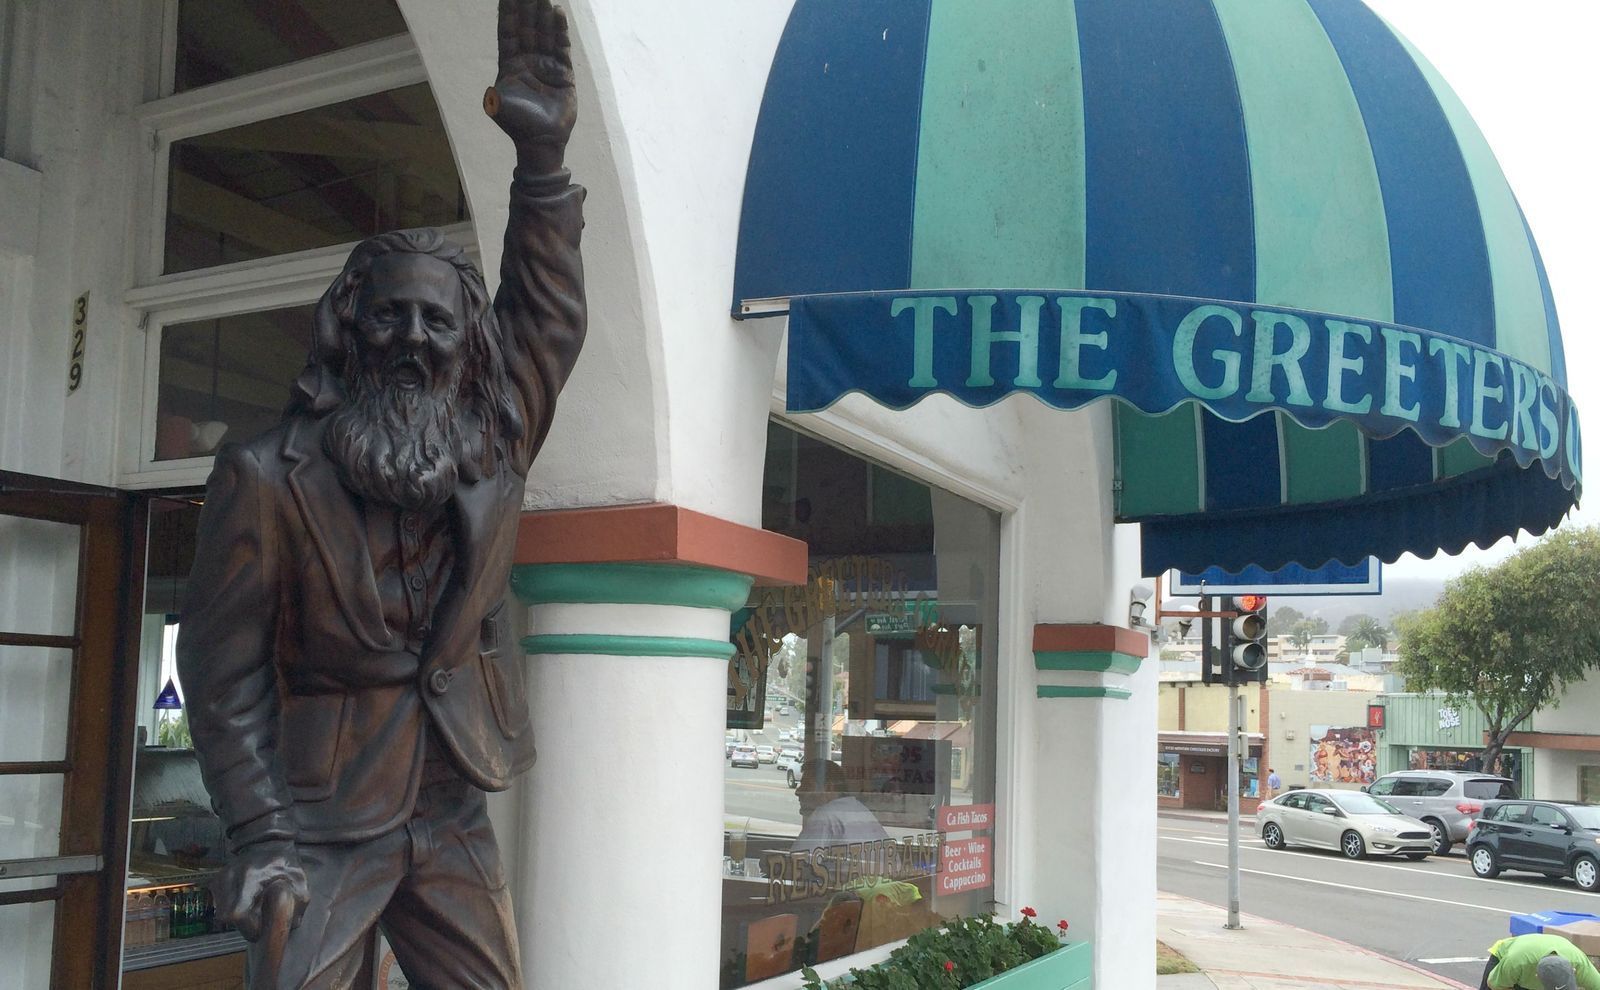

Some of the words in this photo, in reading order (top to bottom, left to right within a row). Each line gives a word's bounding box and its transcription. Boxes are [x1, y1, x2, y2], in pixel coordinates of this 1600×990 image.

[69, 296, 86, 391] 329
[890, 295, 1118, 391] THE
[1172, 304, 1559, 460] GREETER'S
[946, 813, 956, 826] Ca
[957, 811, 970, 825] Fish
[971, 810, 988, 824] Tacos
[944, 845, 962, 858] Beer
[968, 841, 985, 855] Wine
[768, 832, 947, 903] RESTAURANT
[948, 856, 982, 873] Cocktails
[943, 871, 986, 892] Cappuccino
